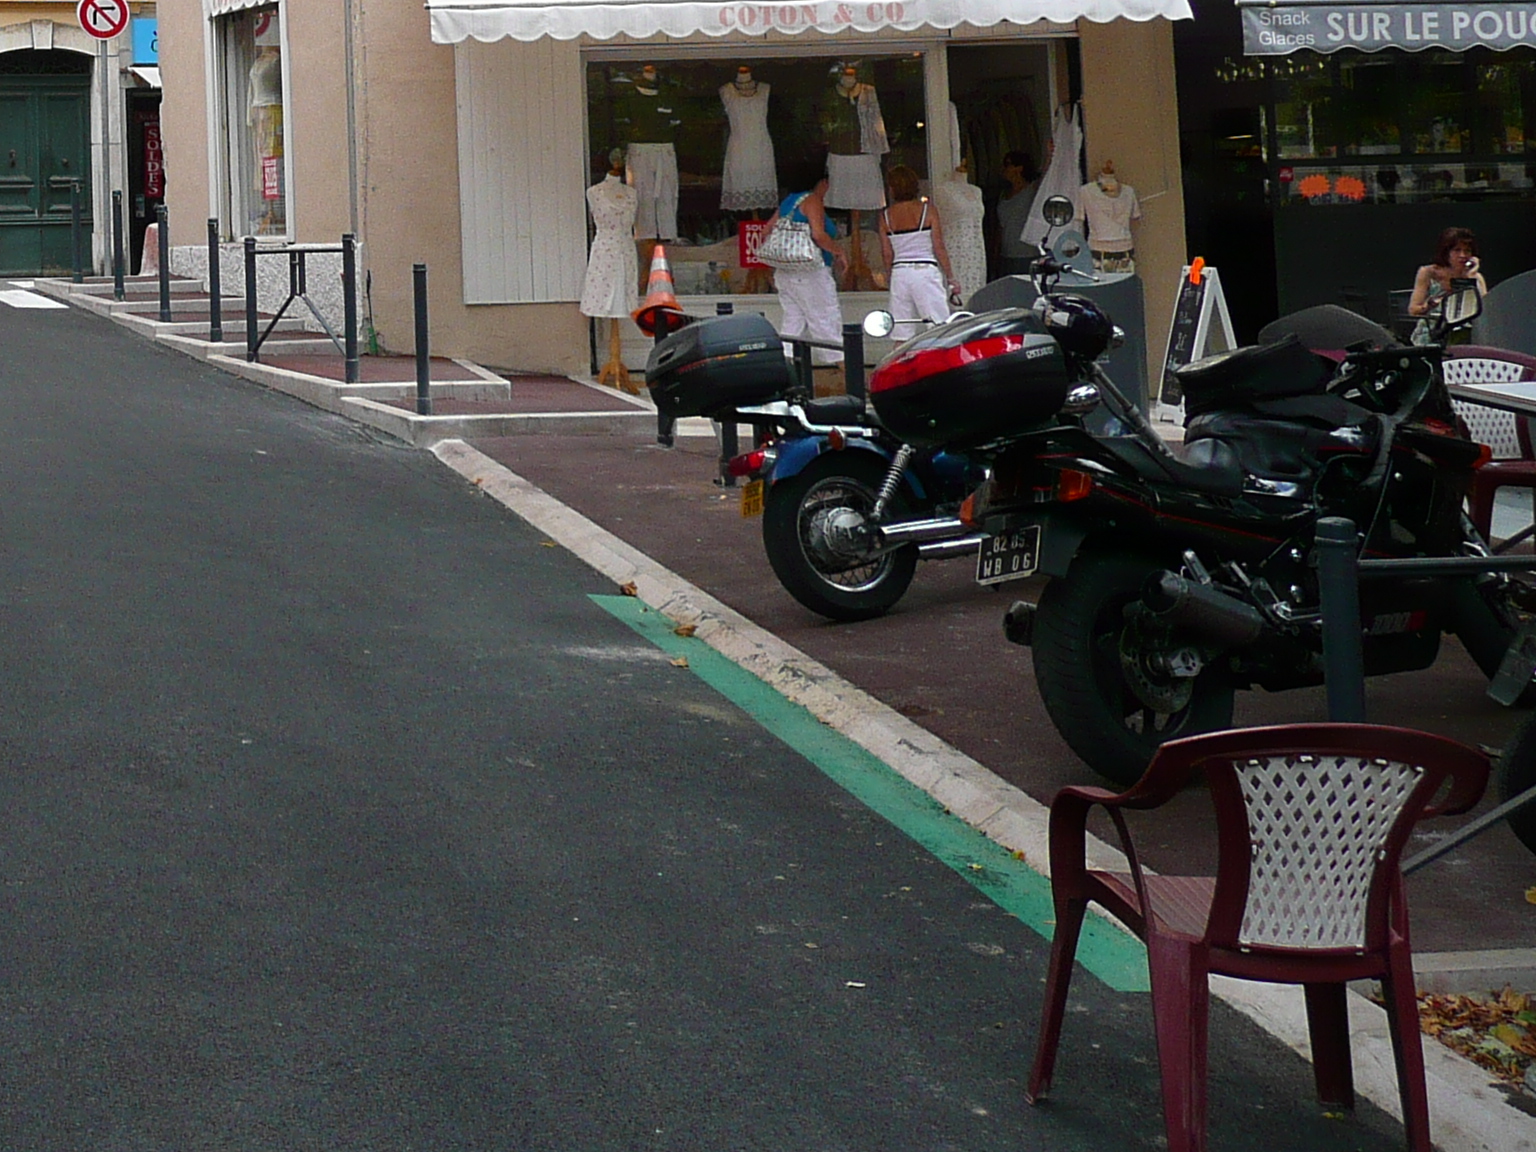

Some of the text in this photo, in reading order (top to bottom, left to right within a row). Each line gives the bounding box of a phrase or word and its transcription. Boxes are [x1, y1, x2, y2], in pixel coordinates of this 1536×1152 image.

[718, 1, 905, 27] COTON & CO
[1259, 11, 1311, 27] Snack
[1326, 11, 1392, 41] SUR
[1404, 11, 1440, 40] LE
[1258, 30, 1315, 47] Glaces
[147, 128, 161, 195] SOLDES
[983, 552, 1031, 578] WB 06
